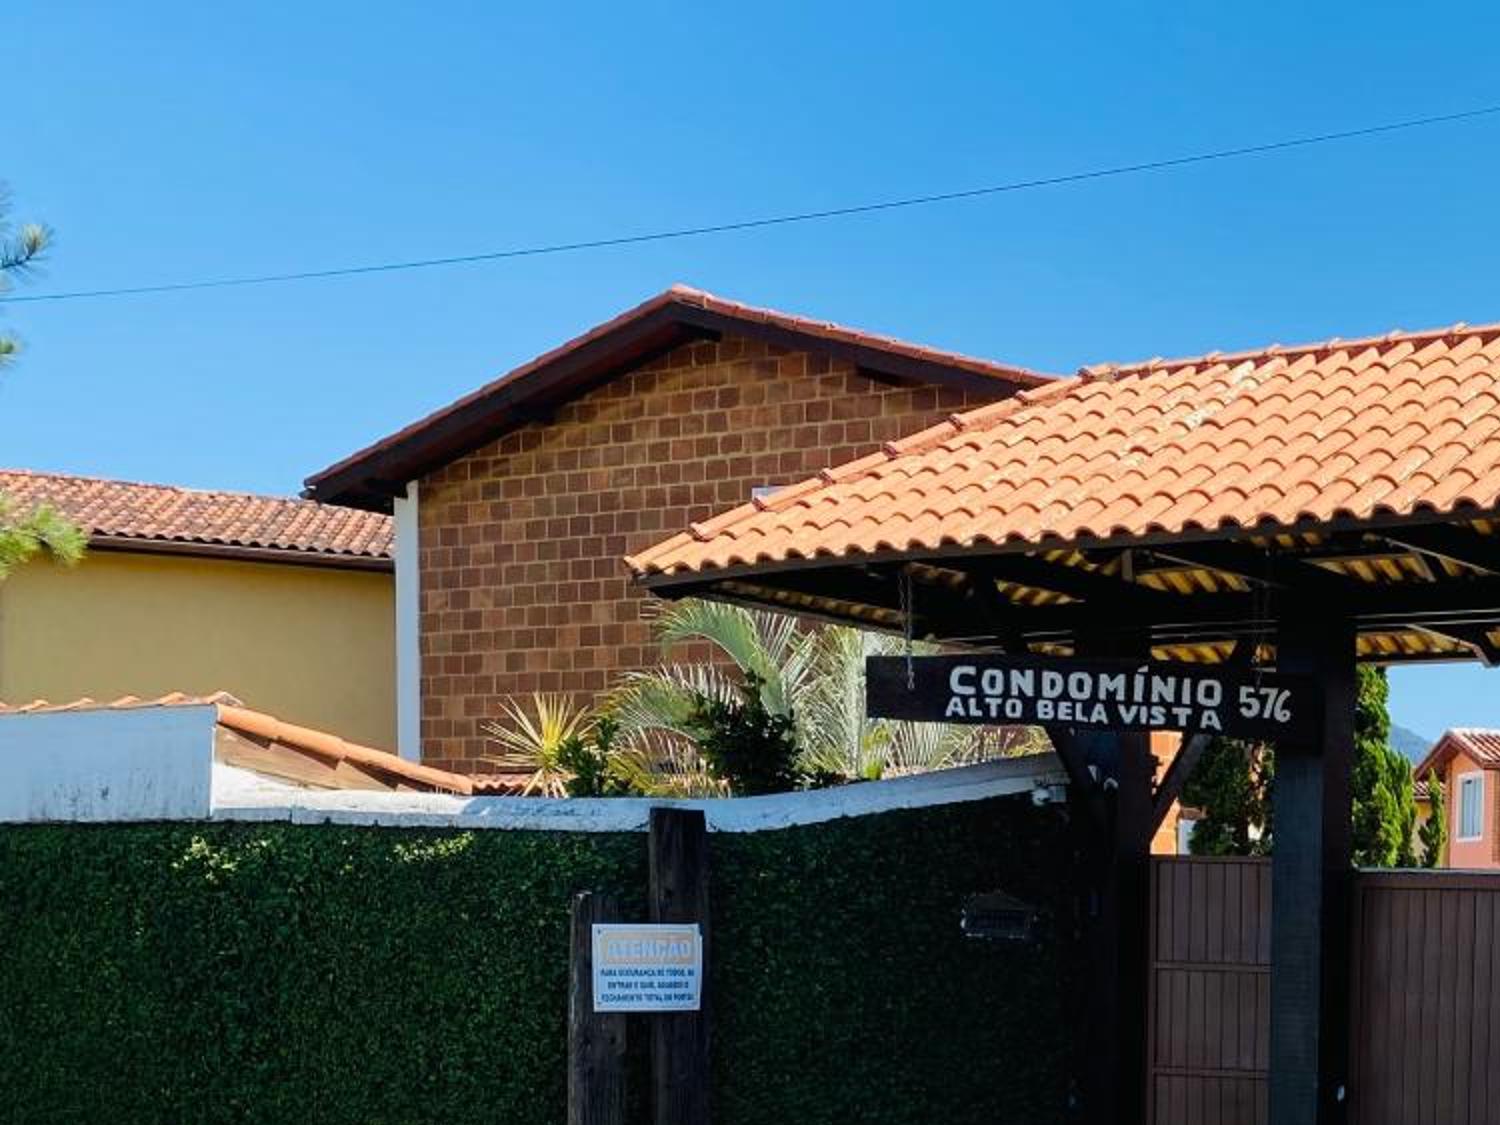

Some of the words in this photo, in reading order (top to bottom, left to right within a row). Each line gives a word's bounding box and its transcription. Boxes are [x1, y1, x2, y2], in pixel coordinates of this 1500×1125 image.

[945, 696, 1022, 719] ALTO
[1037, 699, 1109, 724] BELA
[1118, 704, 1222, 731] VISTA
[950, 665, 1222, 706] CONDOMÍNIO
[1239, 686, 1291, 723] 576
